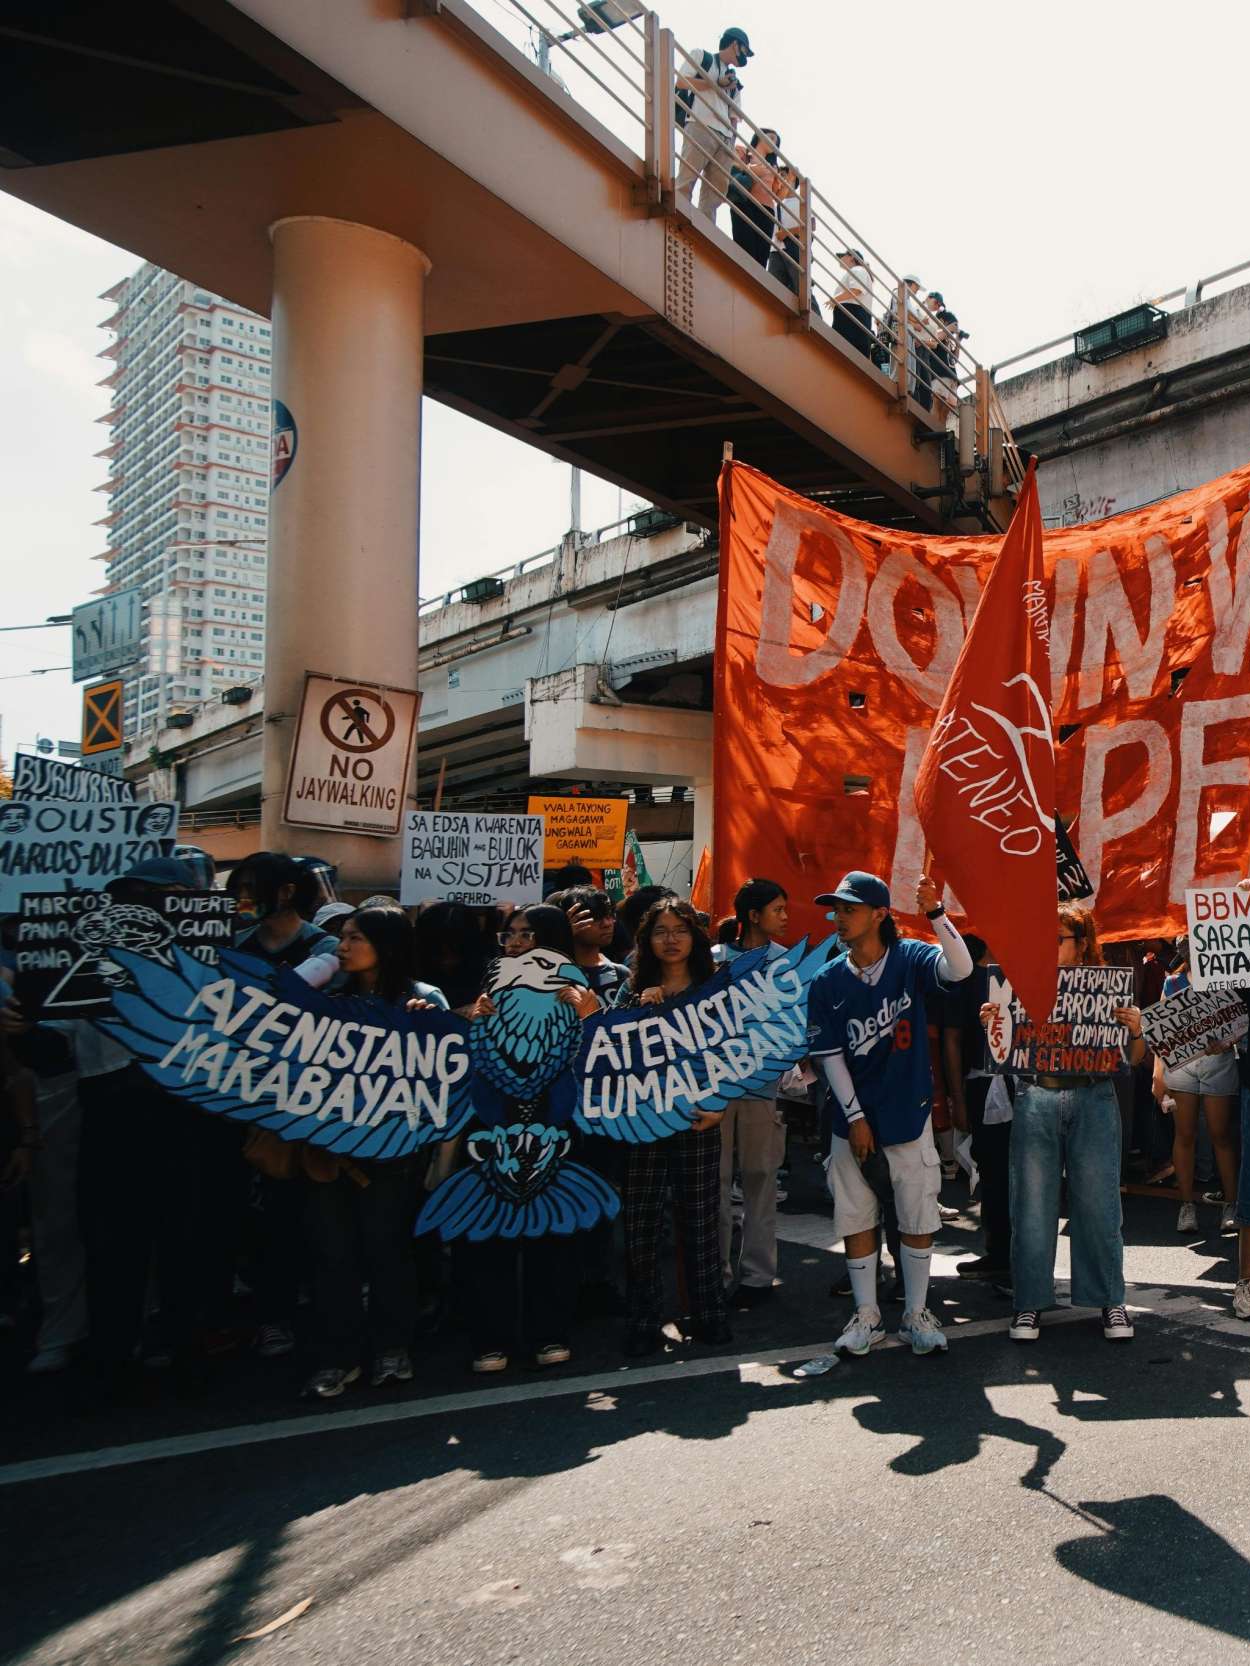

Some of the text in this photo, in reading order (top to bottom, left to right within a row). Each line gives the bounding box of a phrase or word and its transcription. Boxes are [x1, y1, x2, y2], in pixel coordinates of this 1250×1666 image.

[329, 754, 374, 781] NO
[296, 777, 397, 811] JAYWALKING
[544, 803, 612, 814] WALA TAYONG
[550, 815, 605, 824] MAGAGAWA
[408, 814, 428, 832] SA
[432, 815, 469, 835] EDSA
[474, 816, 543, 837] KWARENTA
[566, 826, 592, 837] WALA
[411, 836, 470, 860] BAGUHIN
[488, 836, 538, 861] BULOK
[556, 839, 598, 850] GAGAWIN
[415, 861, 540, 888] NA SISTEMA!
[24, 892, 113, 917] MARCOS
[18, 920, 70, 942] PANA
[16, 950, 73, 972] PANA
[1207, 979, 1247, 992] ATENEO
[584, 957, 804, 1074] ATENISTANG
[184, 977, 469, 1084] ATENISTANG
[1012, 1047, 1122, 1073] IN GENOCIDE
[1162, 1038, 1207, 1069] LAYAS
[158, 1023, 450, 1132] MAKABAYAN
